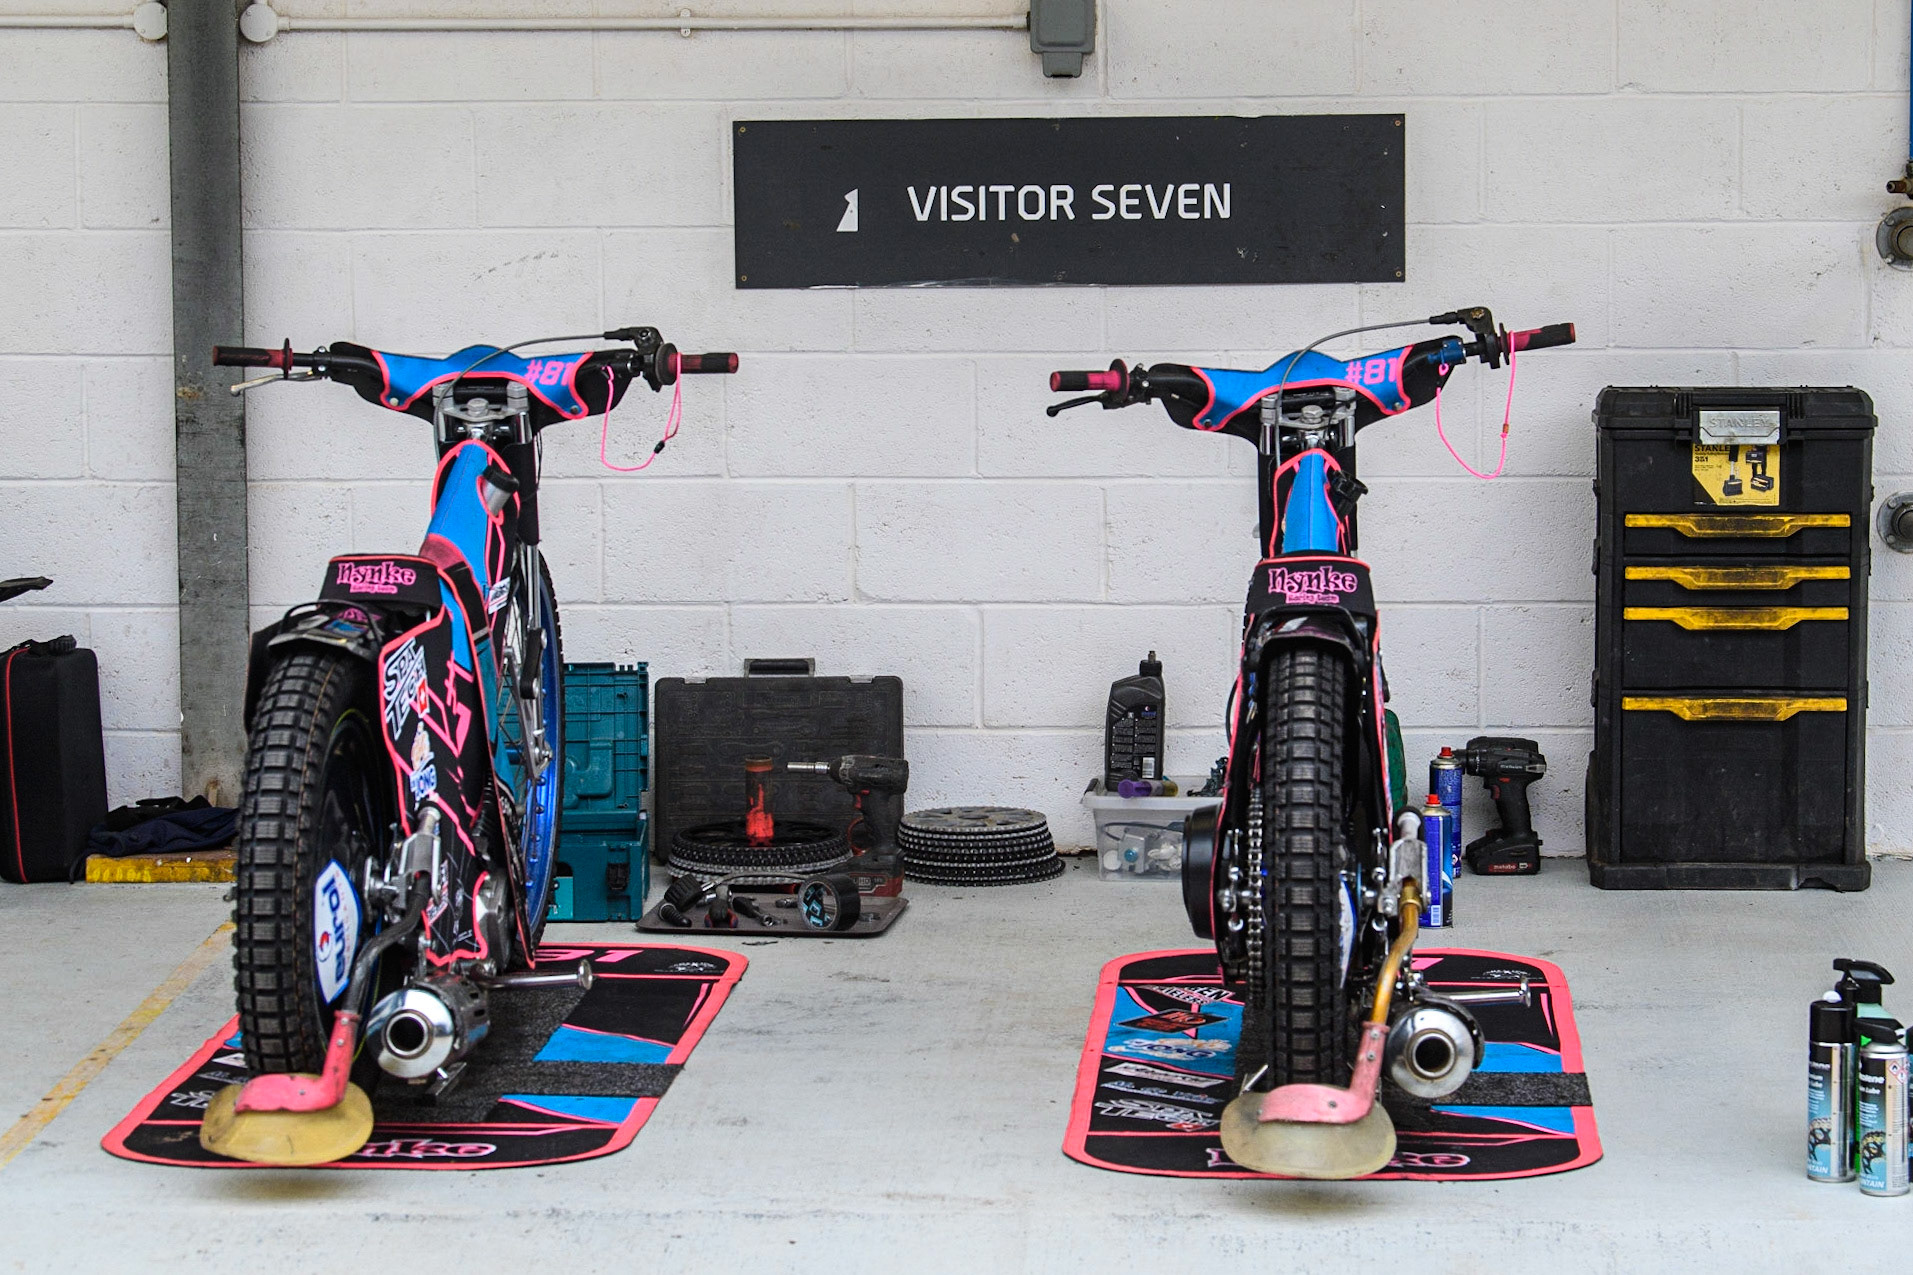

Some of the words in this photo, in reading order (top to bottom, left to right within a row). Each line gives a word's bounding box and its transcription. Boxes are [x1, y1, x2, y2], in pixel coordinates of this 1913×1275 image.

[906, 184, 1075, 221] VISITOR
[1091, 183, 1231, 220] SEVEN
[1346, 357, 1399, 385] #81
[1709, 416, 1770, 428] STANLEY
